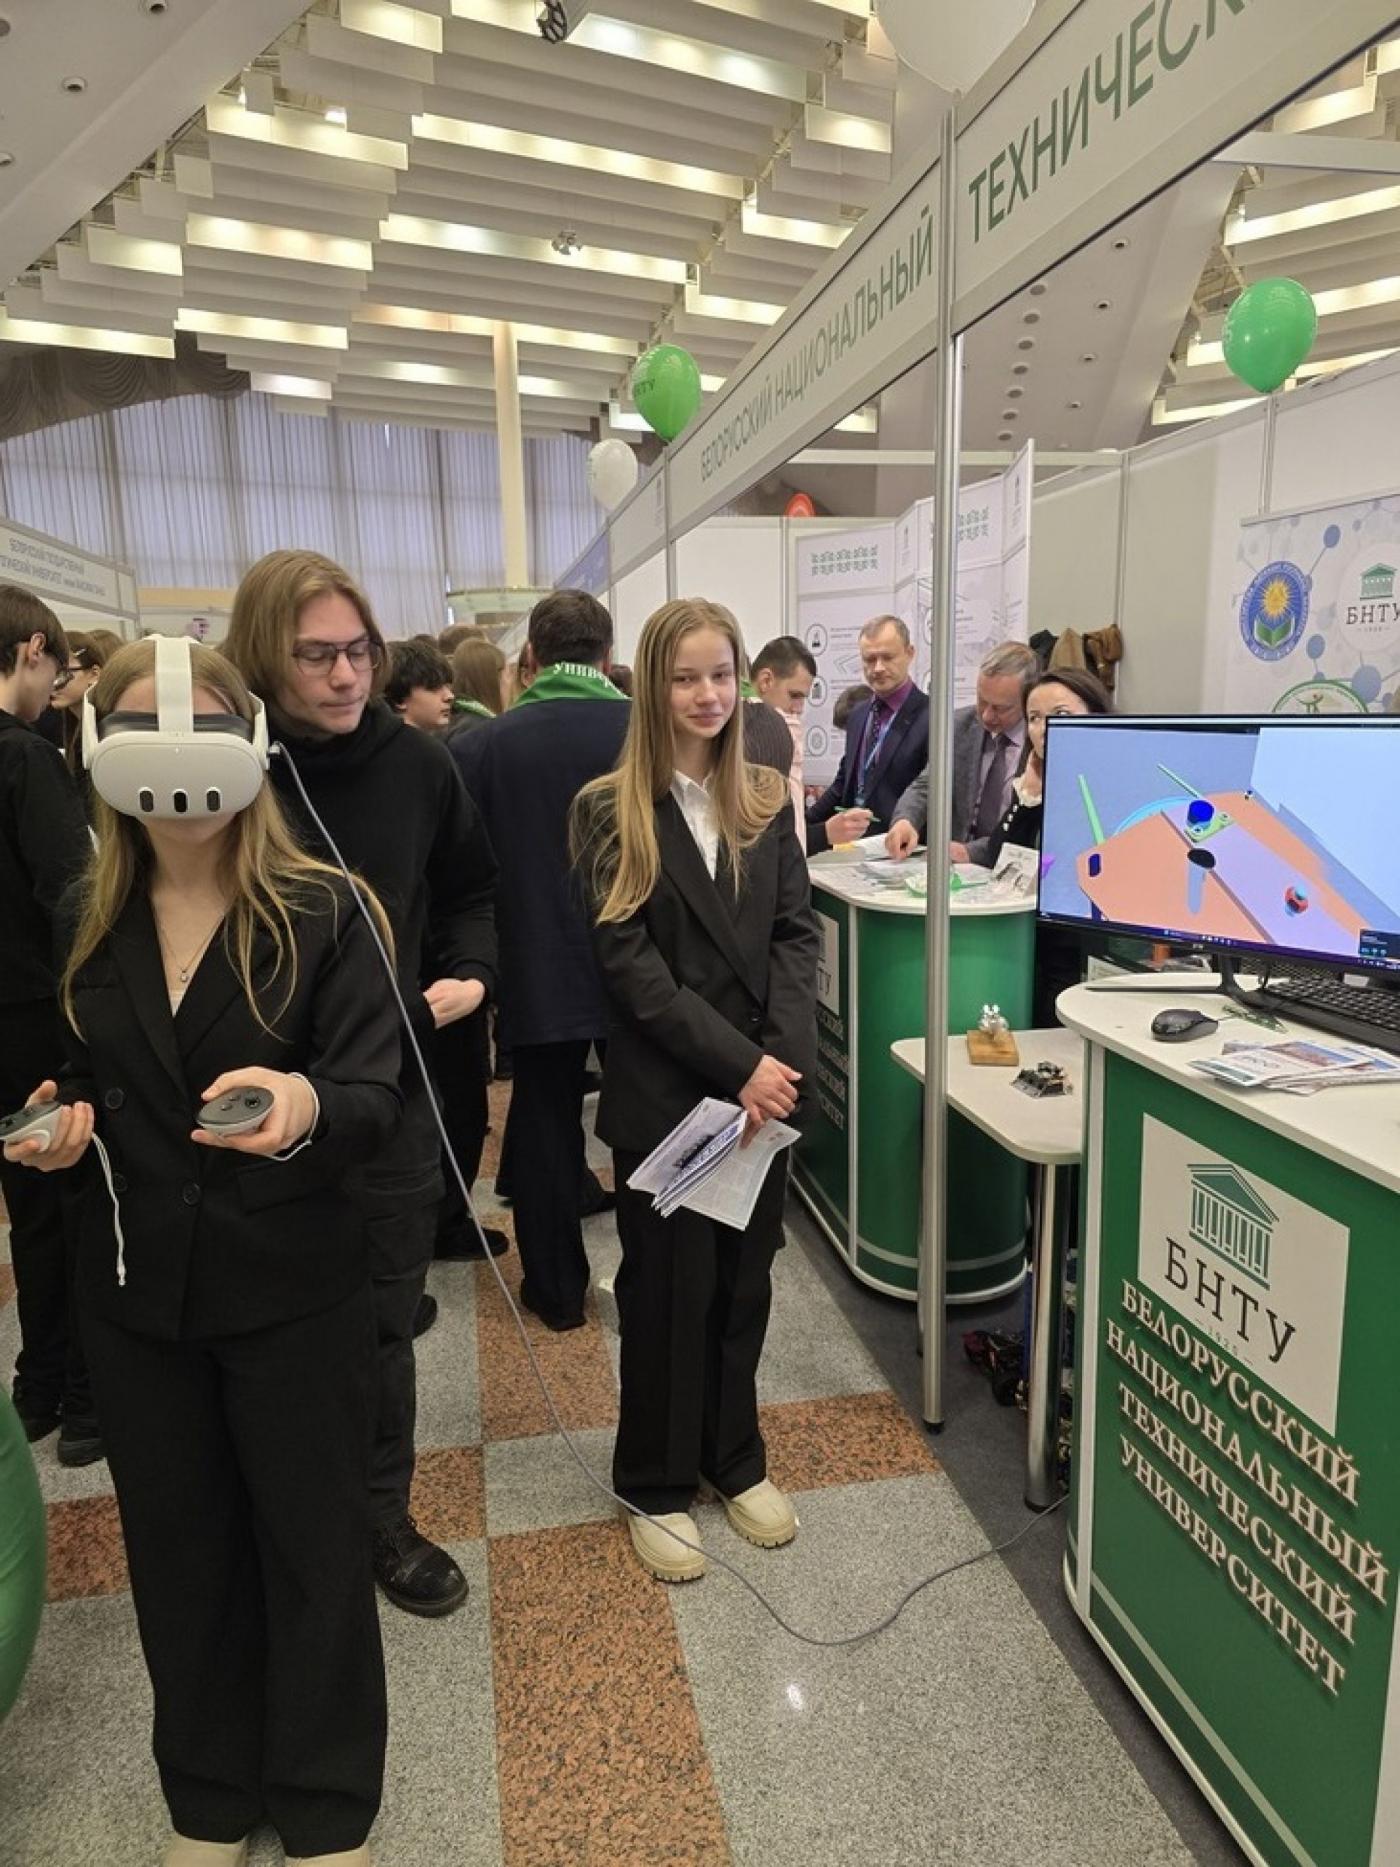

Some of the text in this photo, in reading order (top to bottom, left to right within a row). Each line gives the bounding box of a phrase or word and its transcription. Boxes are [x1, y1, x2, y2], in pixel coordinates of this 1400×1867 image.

[775, 205, 933, 414] НАЦИОНАЛЬНЫЙ
[1122, 1279, 1360, 1507] БЕЛОРУССКИЙ
[1164, 1236, 1296, 1364] БНТУ
[1106, 1318, 1390, 1606] НАЦИОНАЛЬНЫЙ
[1119, 1382, 1356, 1646] ТЕХНИЧЕСКИЙ
[1120, 1436, 1345, 1696] УНИВЕРСИТЕТ
